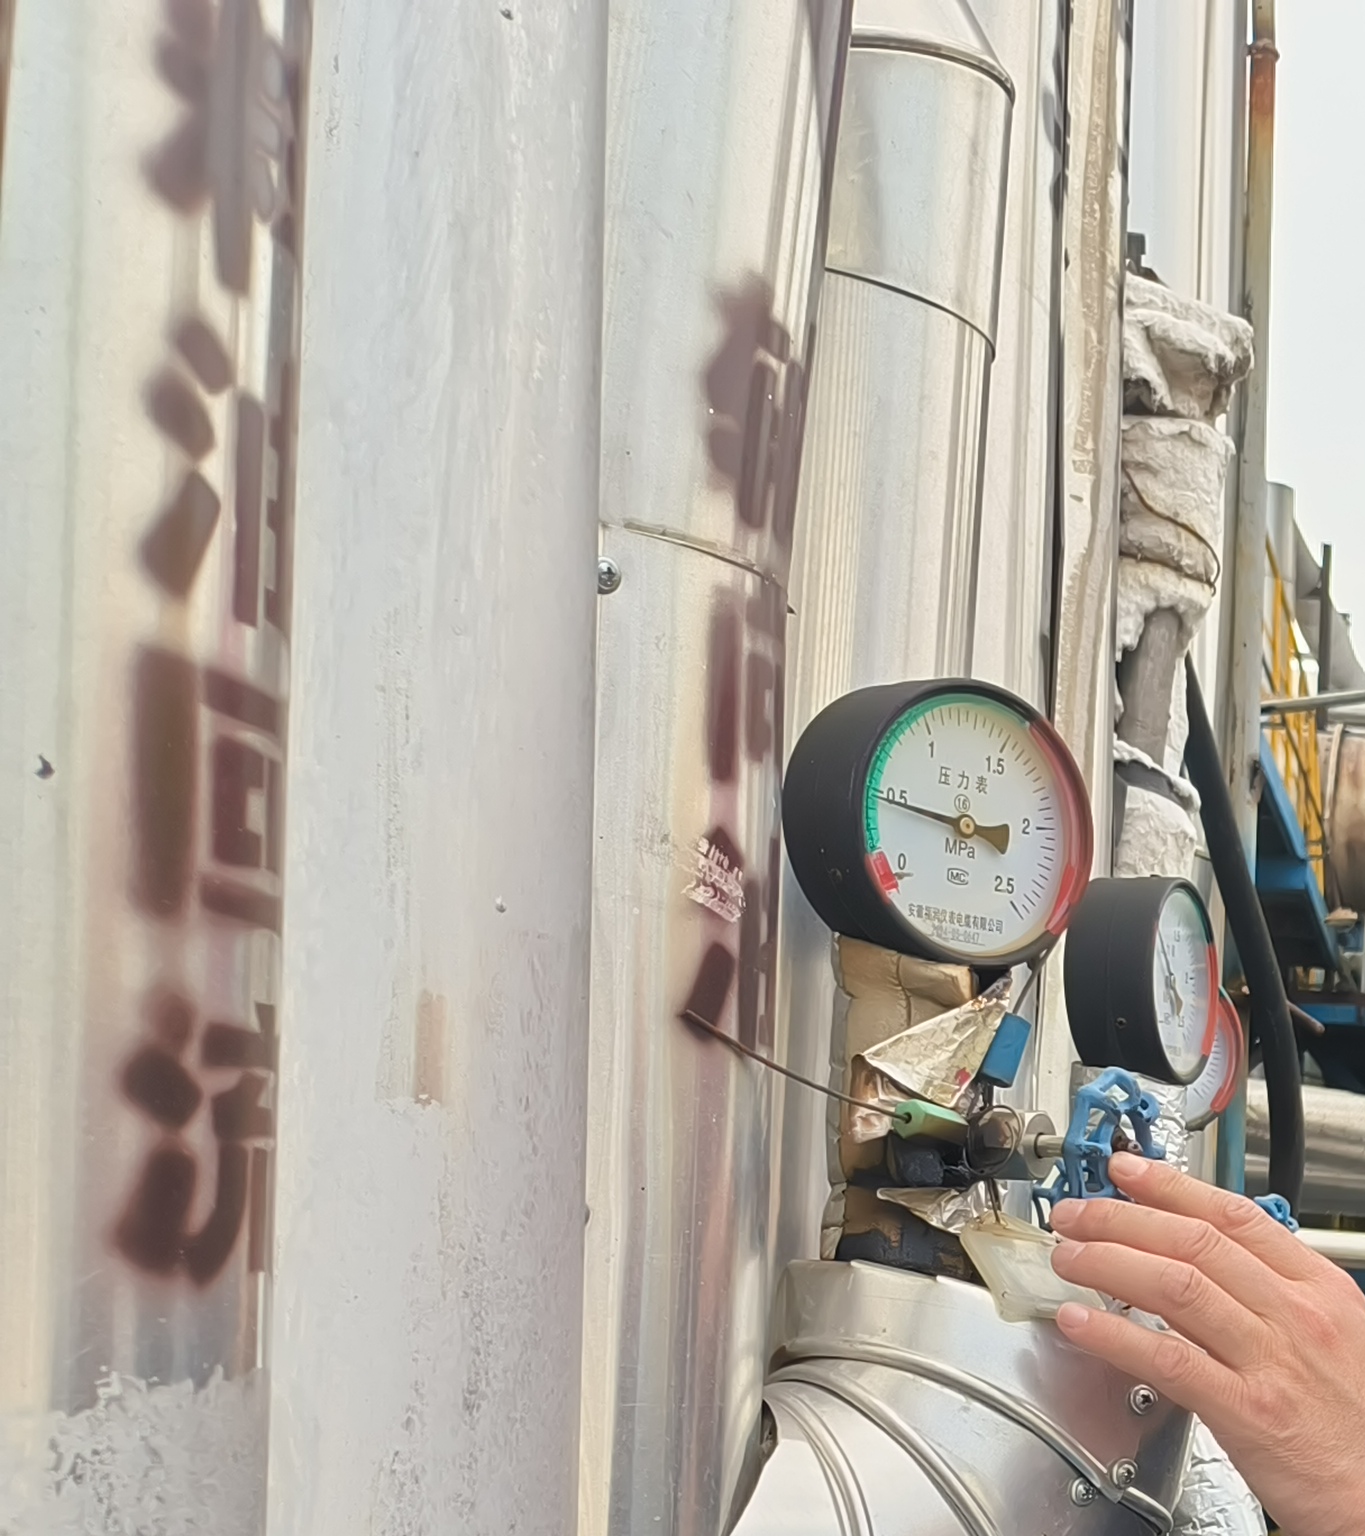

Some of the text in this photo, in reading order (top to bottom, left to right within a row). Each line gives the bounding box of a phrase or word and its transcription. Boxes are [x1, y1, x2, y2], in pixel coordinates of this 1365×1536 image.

[928, 741, 935, 758] 1
[985, 755, 1005, 775] 1.5
[938, 765, 989, 795] 压力表
[886, 786, 908, 805] 05
[1021, 817, 1031, 835] 2
[944, 837, 976, 860] MPa
[897, 853, 907, 871] 0
[993, 875, 1015, 895] 2.5
